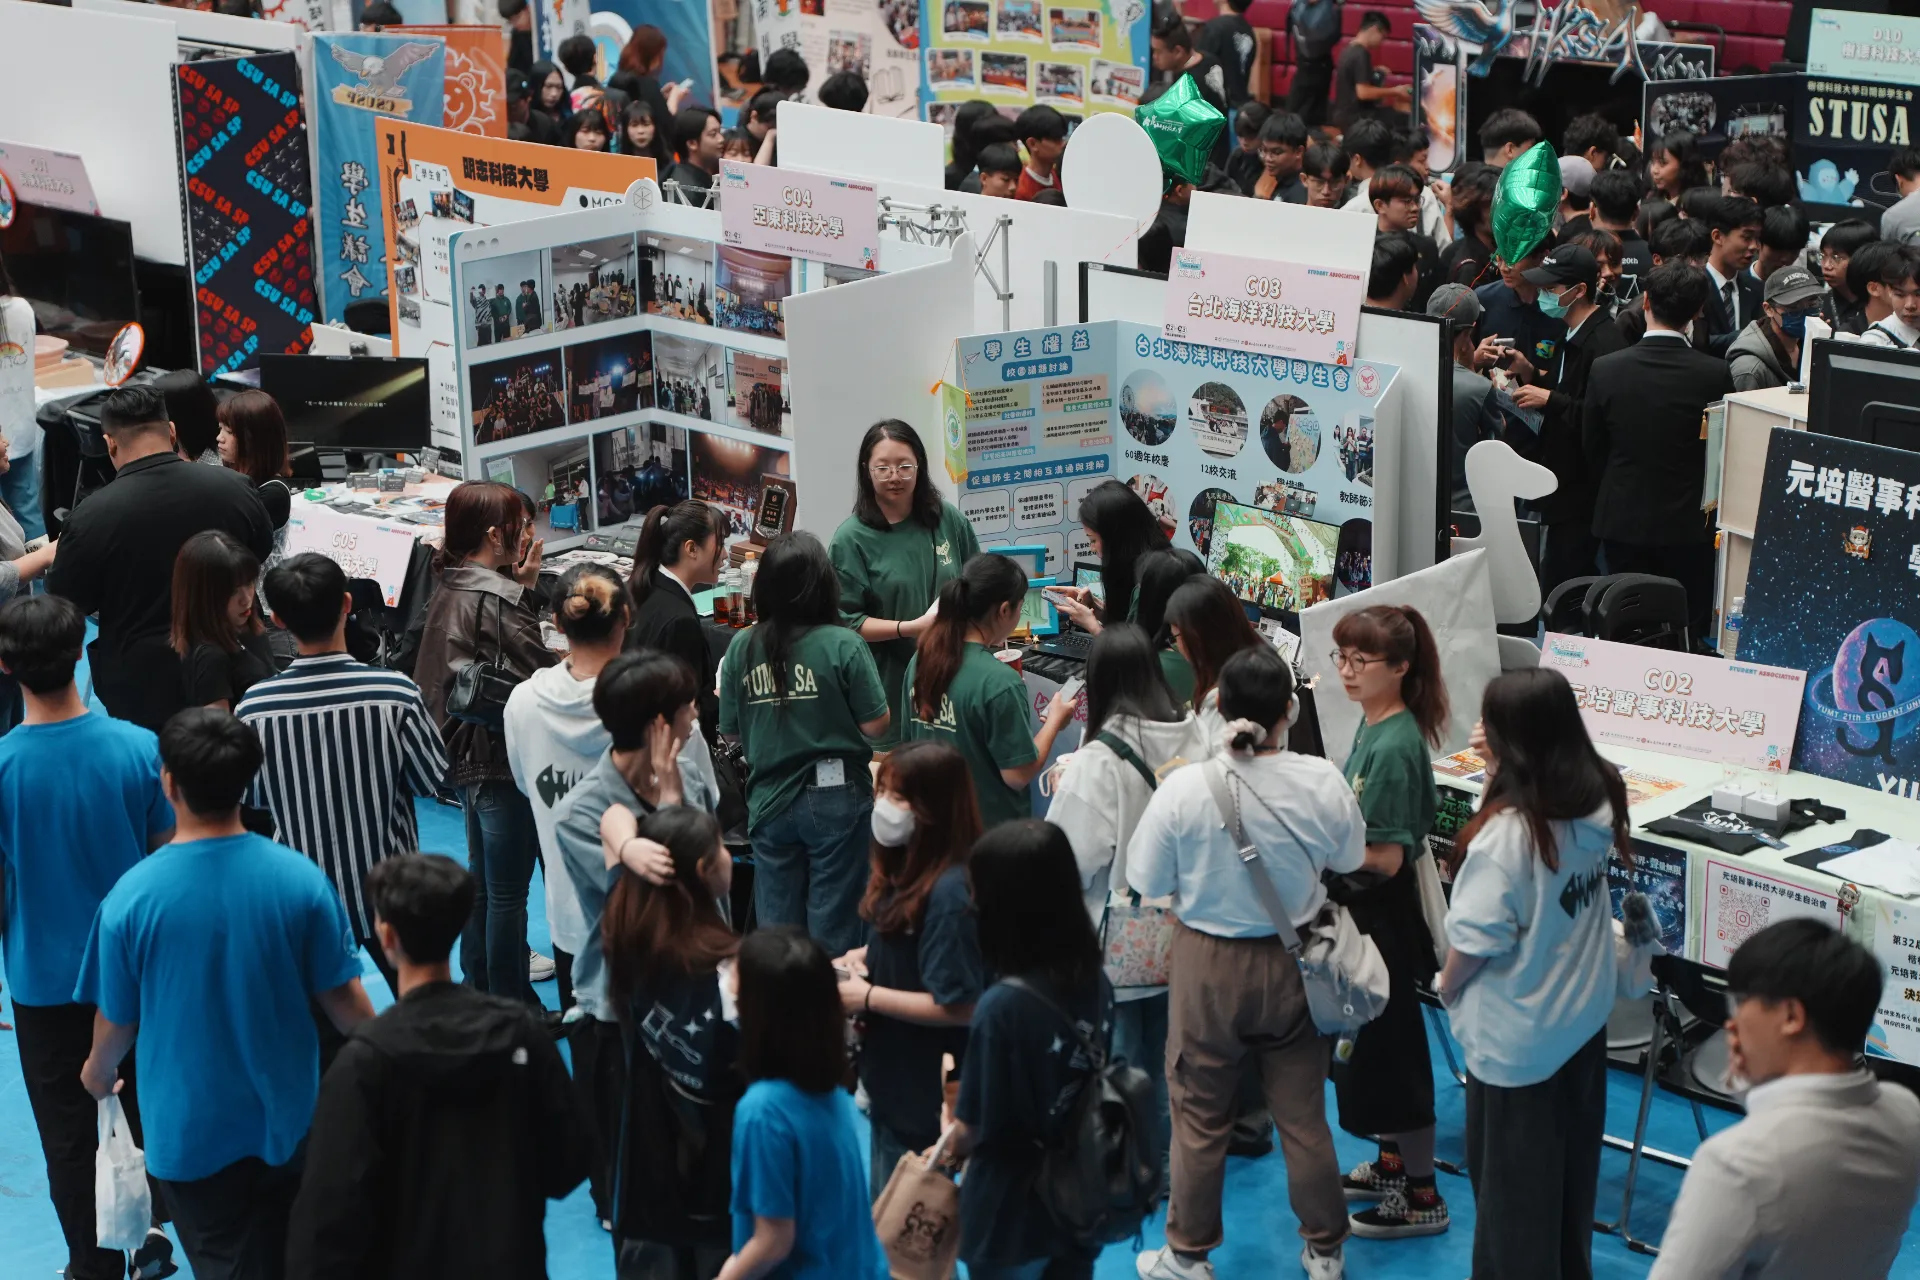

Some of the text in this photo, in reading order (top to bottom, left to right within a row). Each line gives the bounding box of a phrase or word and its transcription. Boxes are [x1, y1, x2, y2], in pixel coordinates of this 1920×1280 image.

[1842, 41, 1920, 64] 樹德科技大
[179, 64, 207, 90] CSU
[204, 84, 223, 104] SA
[236, 57, 264, 84] CSU
[262, 77, 280, 99] SA
[1808, 96, 1911, 146] STUSA
[186, 144, 213, 175] CSU
[210, 130, 229, 151] SA
[244, 137, 270, 167] CSU
[268, 123, 288, 145] SA
[246, 169, 274, 195] CSU
[271, 188, 290, 209] SA
[462, 156, 550, 193] 明志科技大學
[188, 177, 216, 203] CSU
[214, 195, 232, 216] SA
[782, 186, 813, 208] C04
[752, 204, 845, 240] 亞東科技大學
[195, 255, 222, 285] CSU
[219, 240, 239, 262] SA
[253, 247, 279, 276] CSU
[277, 232, 296, 254] SA
[197, 287, 225, 312] CSU
[222, 304, 241, 325] SA
[254, 278, 282, 303] CSU
[279, 296, 297, 317] SA
[1245, 275, 1282, 299] C03
[1188, 292, 1335, 335] 台北海洋科技大學
[984, 329, 1091, 362] 學生權益
[1135, 333, 1350, 392] 台北海洋科技大學學生會
[1125, 450, 1169, 468] 60週年校慶
[1201, 464, 1237, 481] 12校交流
[1339, 490, 1374, 508] 教師節
[332, 530, 358, 550] C05
[1643, 667, 1693, 696] C02
[1728, 665, 1800, 682] STUDENT ASSOCIATION
[1816, 703, 1840, 718] YUMT
[1842, 711, 1861, 722] 21th
[1865, 707, 1904, 721] STUDENT
[1722, 871, 1828, 910] 元培醫事科技大學學生自治會
